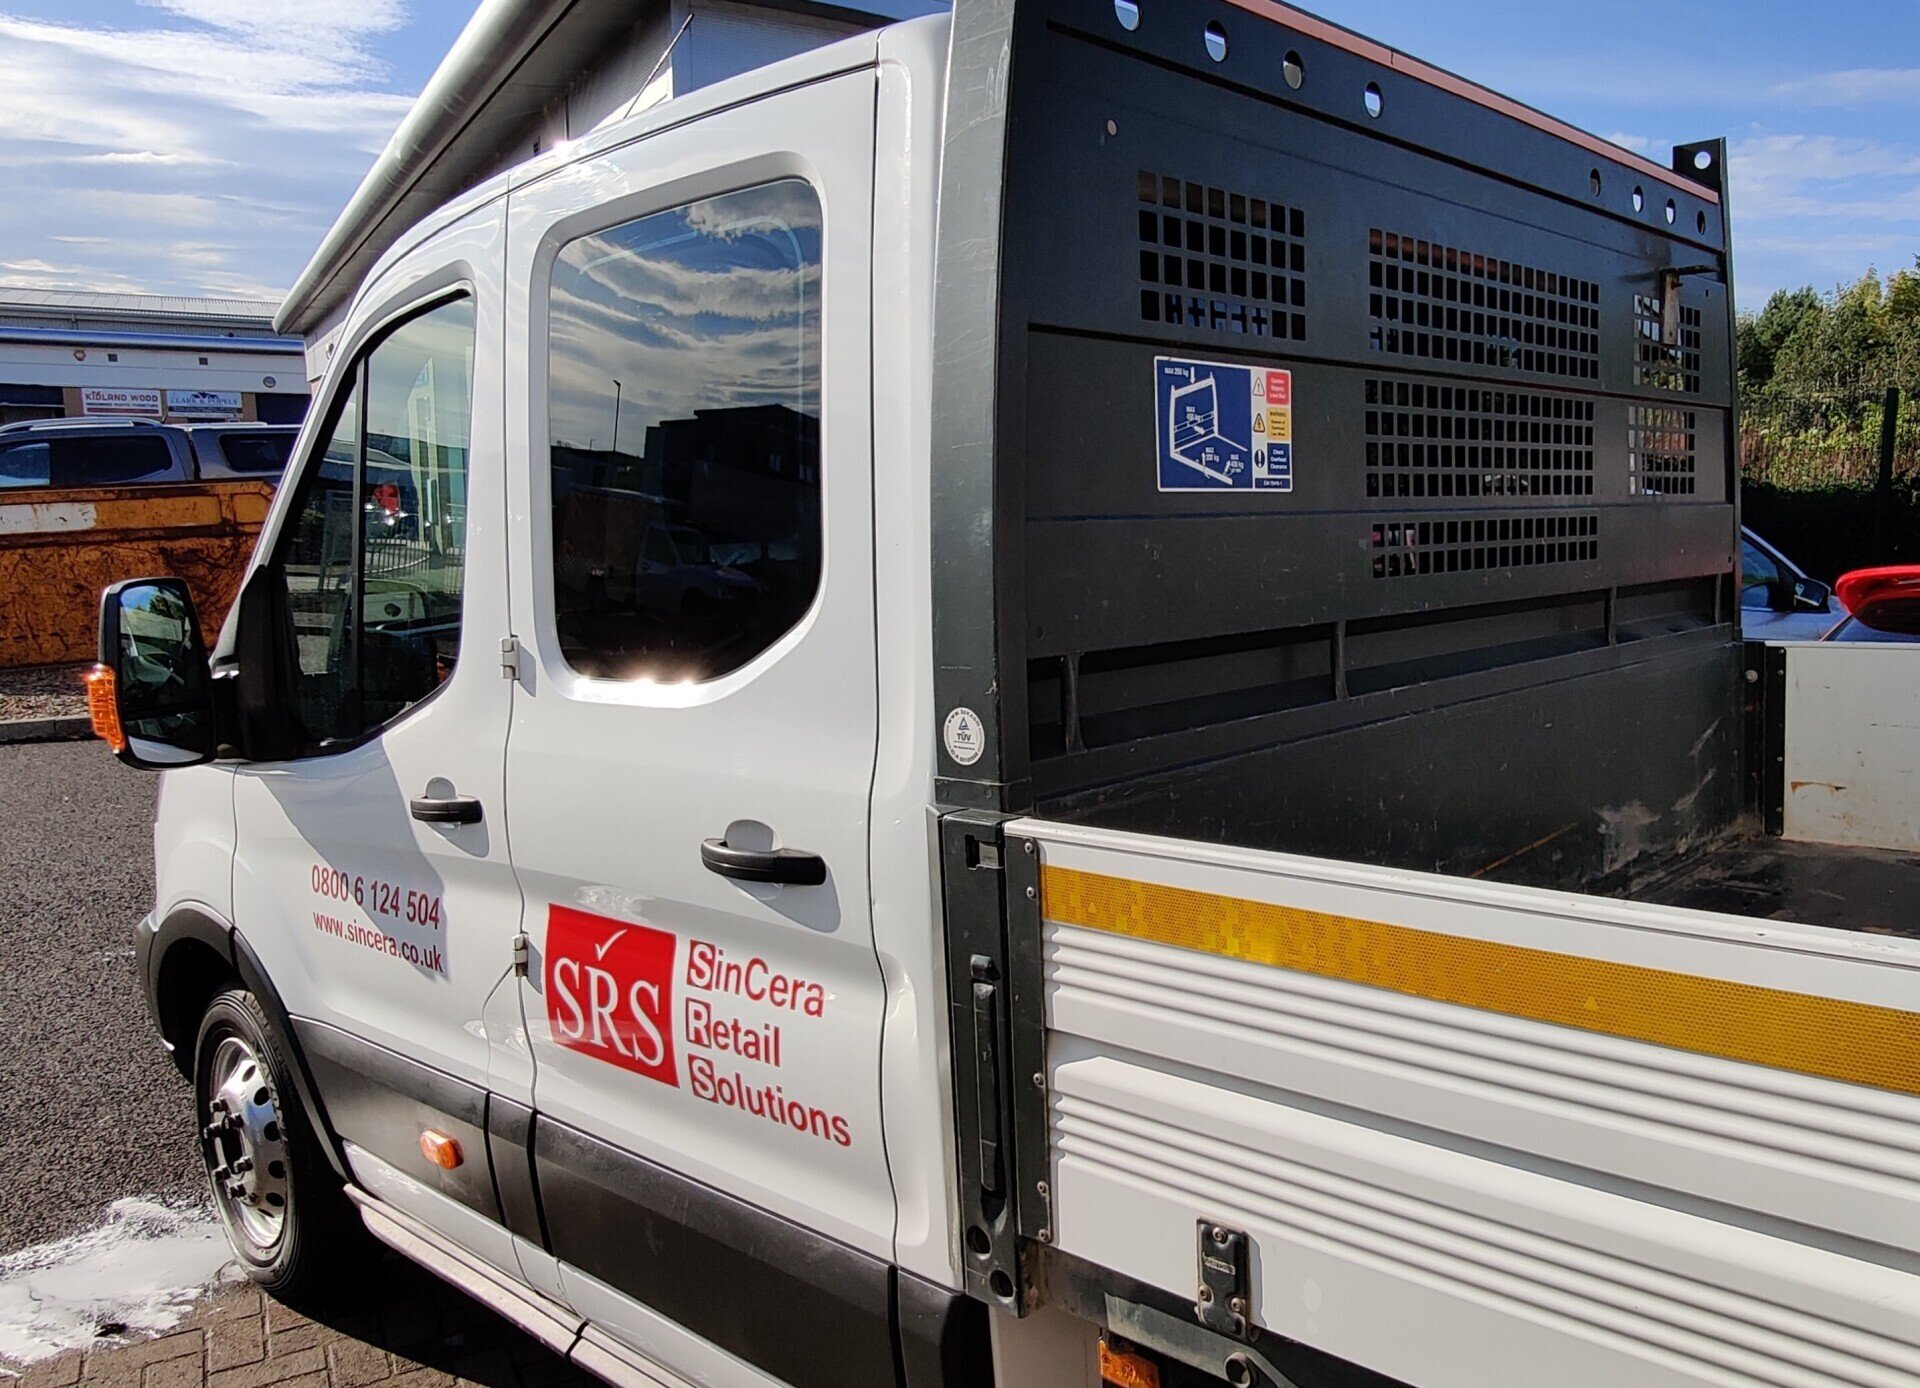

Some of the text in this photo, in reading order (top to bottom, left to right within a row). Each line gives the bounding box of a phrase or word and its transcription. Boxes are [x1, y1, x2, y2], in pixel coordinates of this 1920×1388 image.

[85, 390, 159, 403] KIDLAND WOOD
[1164, 367, 1174, 375] MAX
[1182, 368, 1189, 378] kg
[956, 731, 971, 742] TÜV
[312, 864, 440, 930] 0800 6 124 504
[313, 911, 443, 973] www.sincera.co.uk
[686, 939, 825, 1018] SinCera
[554, 957, 665, 1067] SRS
[685, 997, 781, 1067] Retail
[687, 1053, 852, 1147] Solutions
